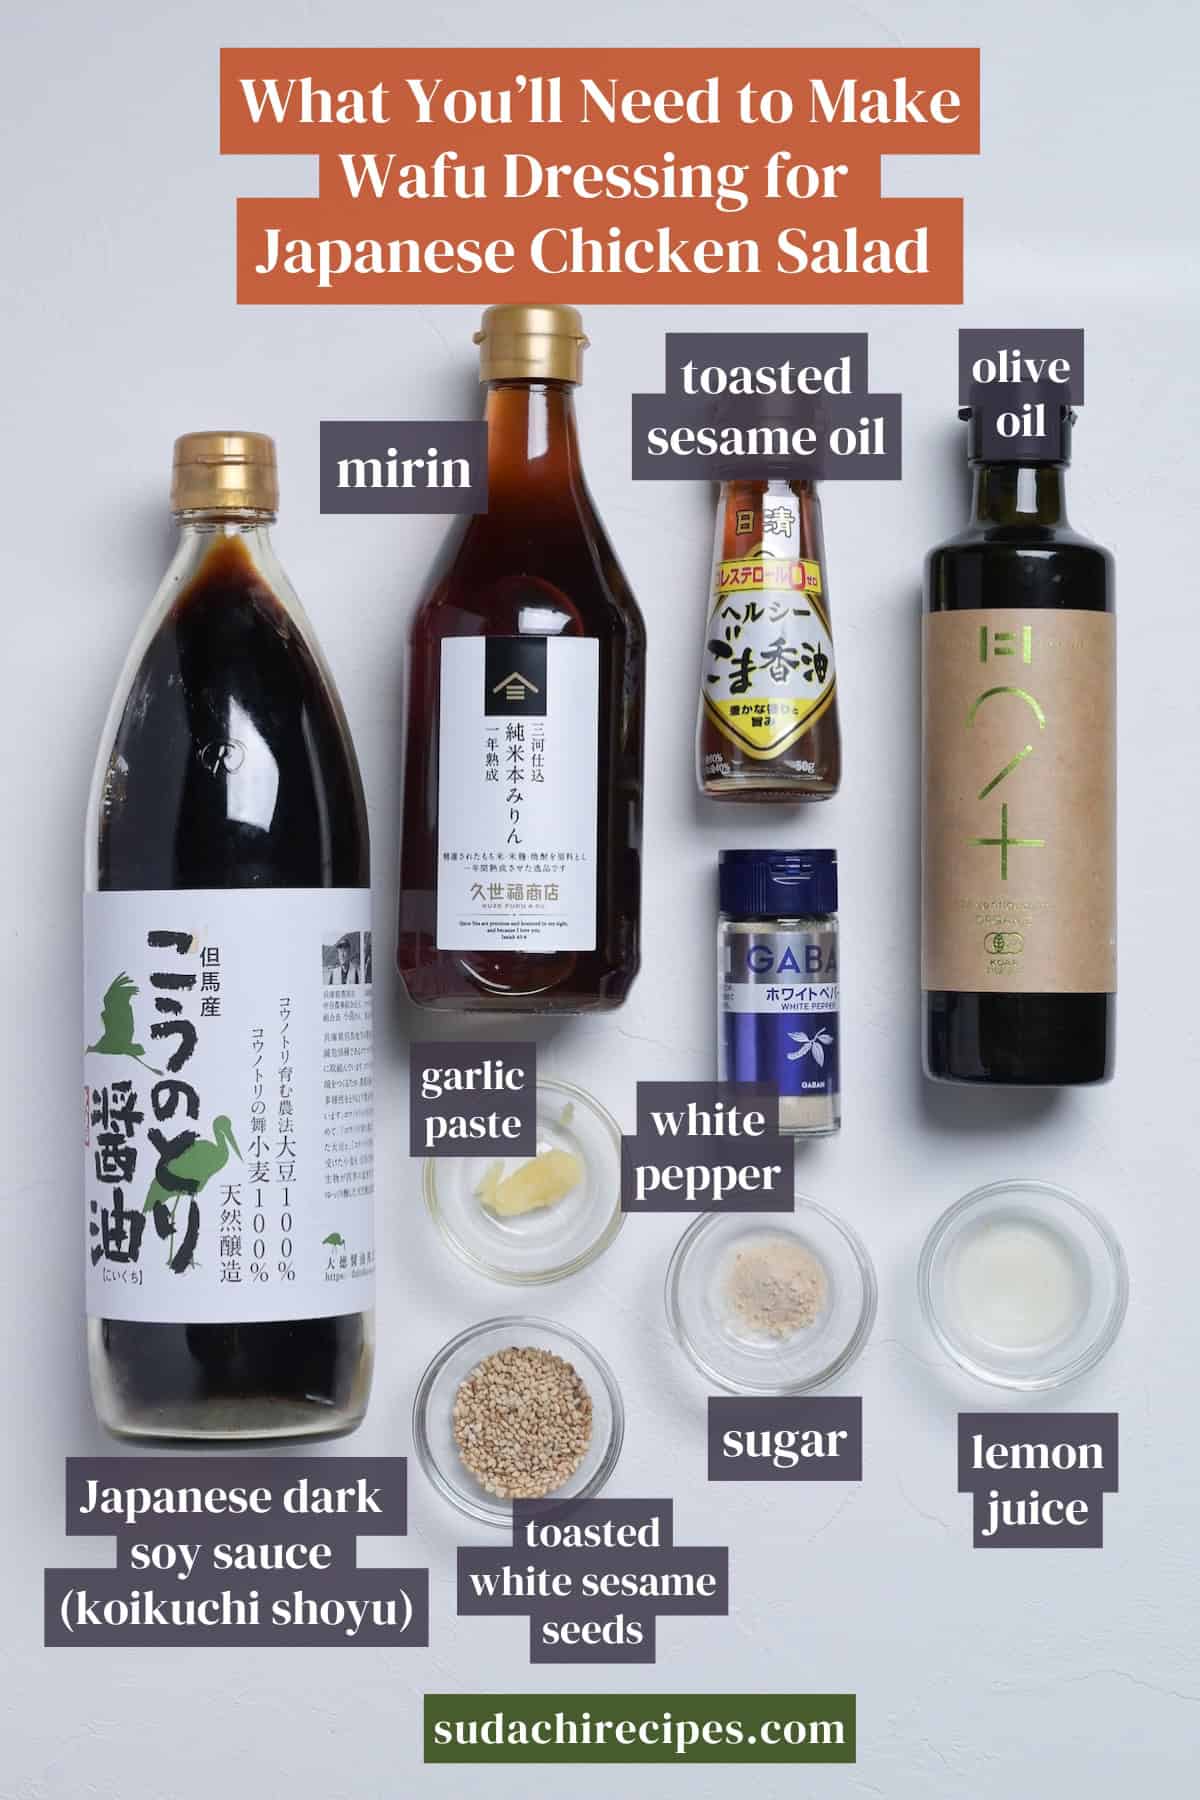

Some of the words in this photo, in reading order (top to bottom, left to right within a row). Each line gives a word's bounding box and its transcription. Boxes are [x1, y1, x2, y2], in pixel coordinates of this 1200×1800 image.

[736, 506, 796, 538] 日清
[721, 602, 811, 624] ヘルシー
[707, 624, 828, 694] ごま香油
[485, 726, 500, 782] 一年熟成
[531, 723, 544, 783] 三河仕込
[505, 722, 525, 844] 純米本みりん
[470, 882, 560, 901] 久世福商店
[200, 946, 221, 1017] 但馬産
[781, 1001, 809, 1010] WHITE
[147, 930, 201, 1274] こうのとり
[801, 1081, 825, 1089] GABAN
[220, 1183, 242, 1283] 天然醸造
